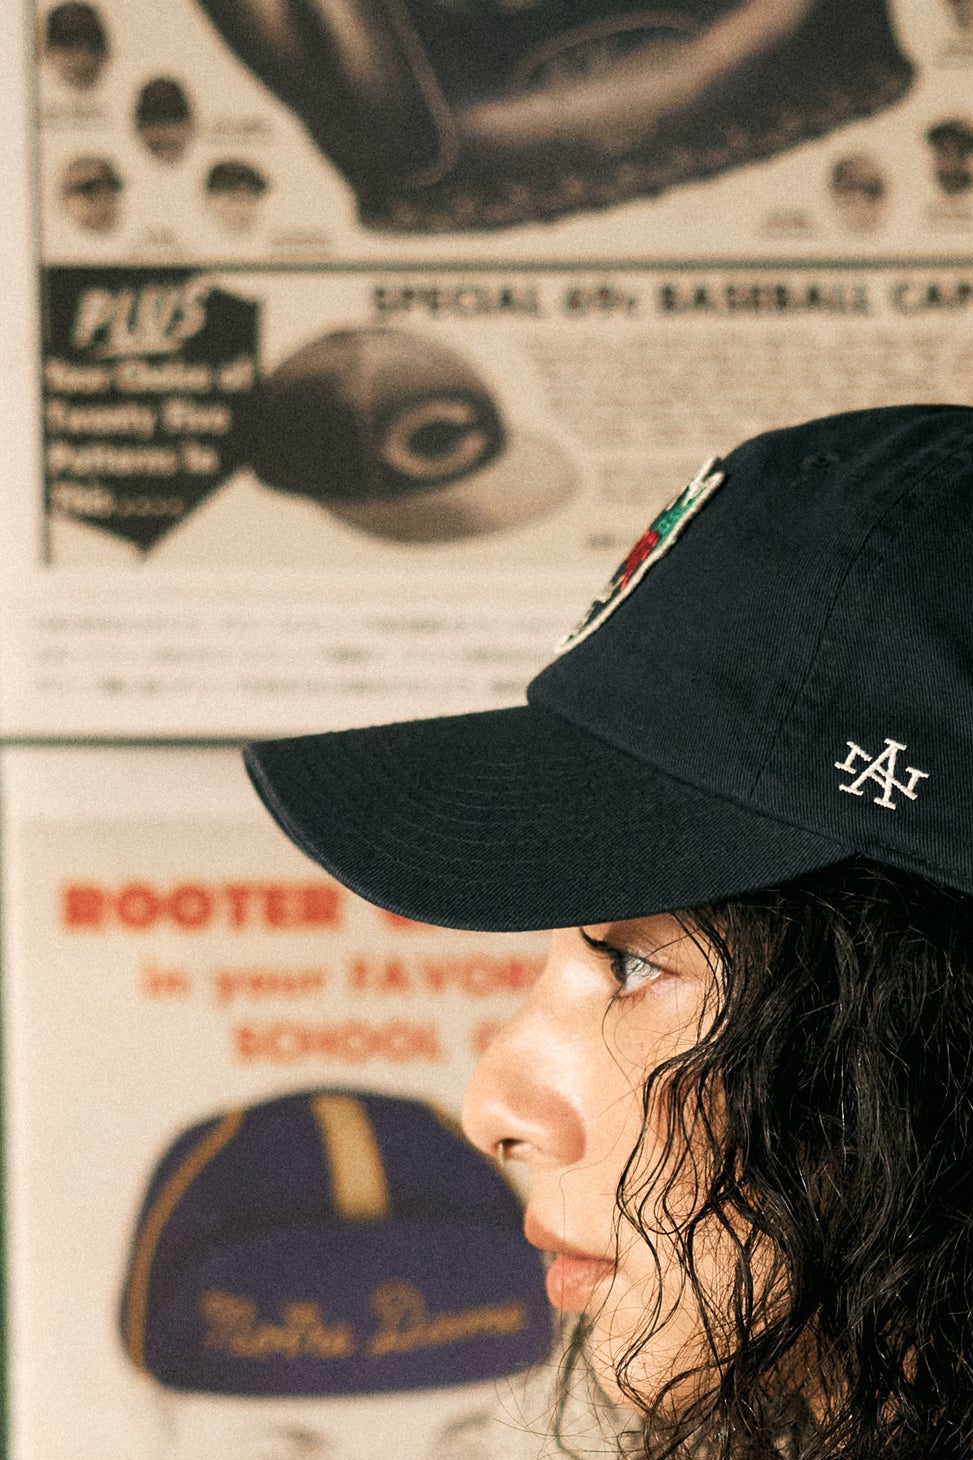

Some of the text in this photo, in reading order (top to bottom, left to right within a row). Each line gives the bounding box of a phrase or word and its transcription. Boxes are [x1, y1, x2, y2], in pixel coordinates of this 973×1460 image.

[74, 284, 206, 348] PLUS
[373, 282, 538, 316] SPECIAL
[657, 282, 870, 315] BASEBALL
[63, 880, 340, 929] ROOTER
[141, 955, 546, 1005] in your FAVOR
[234, 1020, 443, 1064] SCHOOL
